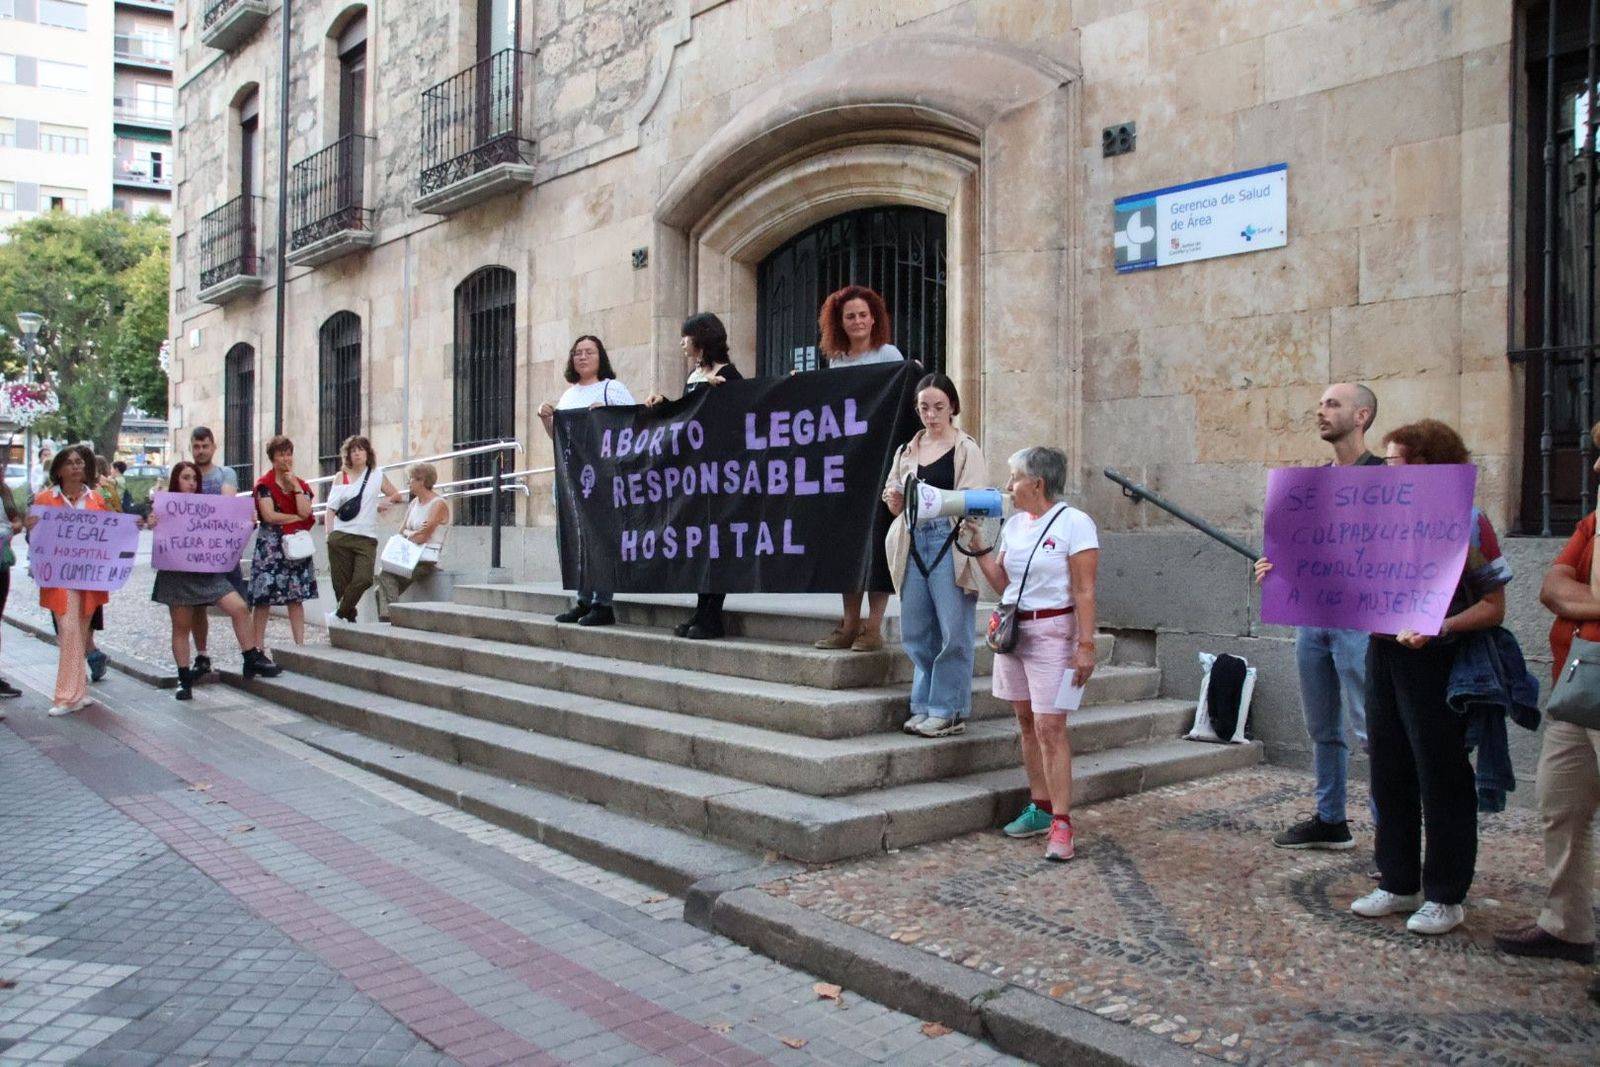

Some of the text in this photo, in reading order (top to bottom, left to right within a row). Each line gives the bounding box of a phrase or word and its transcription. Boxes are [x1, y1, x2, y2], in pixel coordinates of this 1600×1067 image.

[1170, 185, 1271, 215] Gerencia de Salud
[1170, 213, 1212, 232] de Área
[600, 398, 868, 458] ABORTO LEGAL
[612, 455, 845, 508] RESPONSABLE
[1286, 483, 1414, 511] SE SIGUE
[54, 512, 98, 525] ABORTO
[103, 517, 119, 527] ES
[57, 524, 109, 542] LEGAL
[620, 519, 805, 562] HOSPITAL
[54, 545, 111, 561] HOSPITAL
[208, 537, 223, 549] DE
[225, 537, 242, 550] MIS
[60, 562, 105, 582] CUMPLE
[1287, 587, 1301, 606] A
